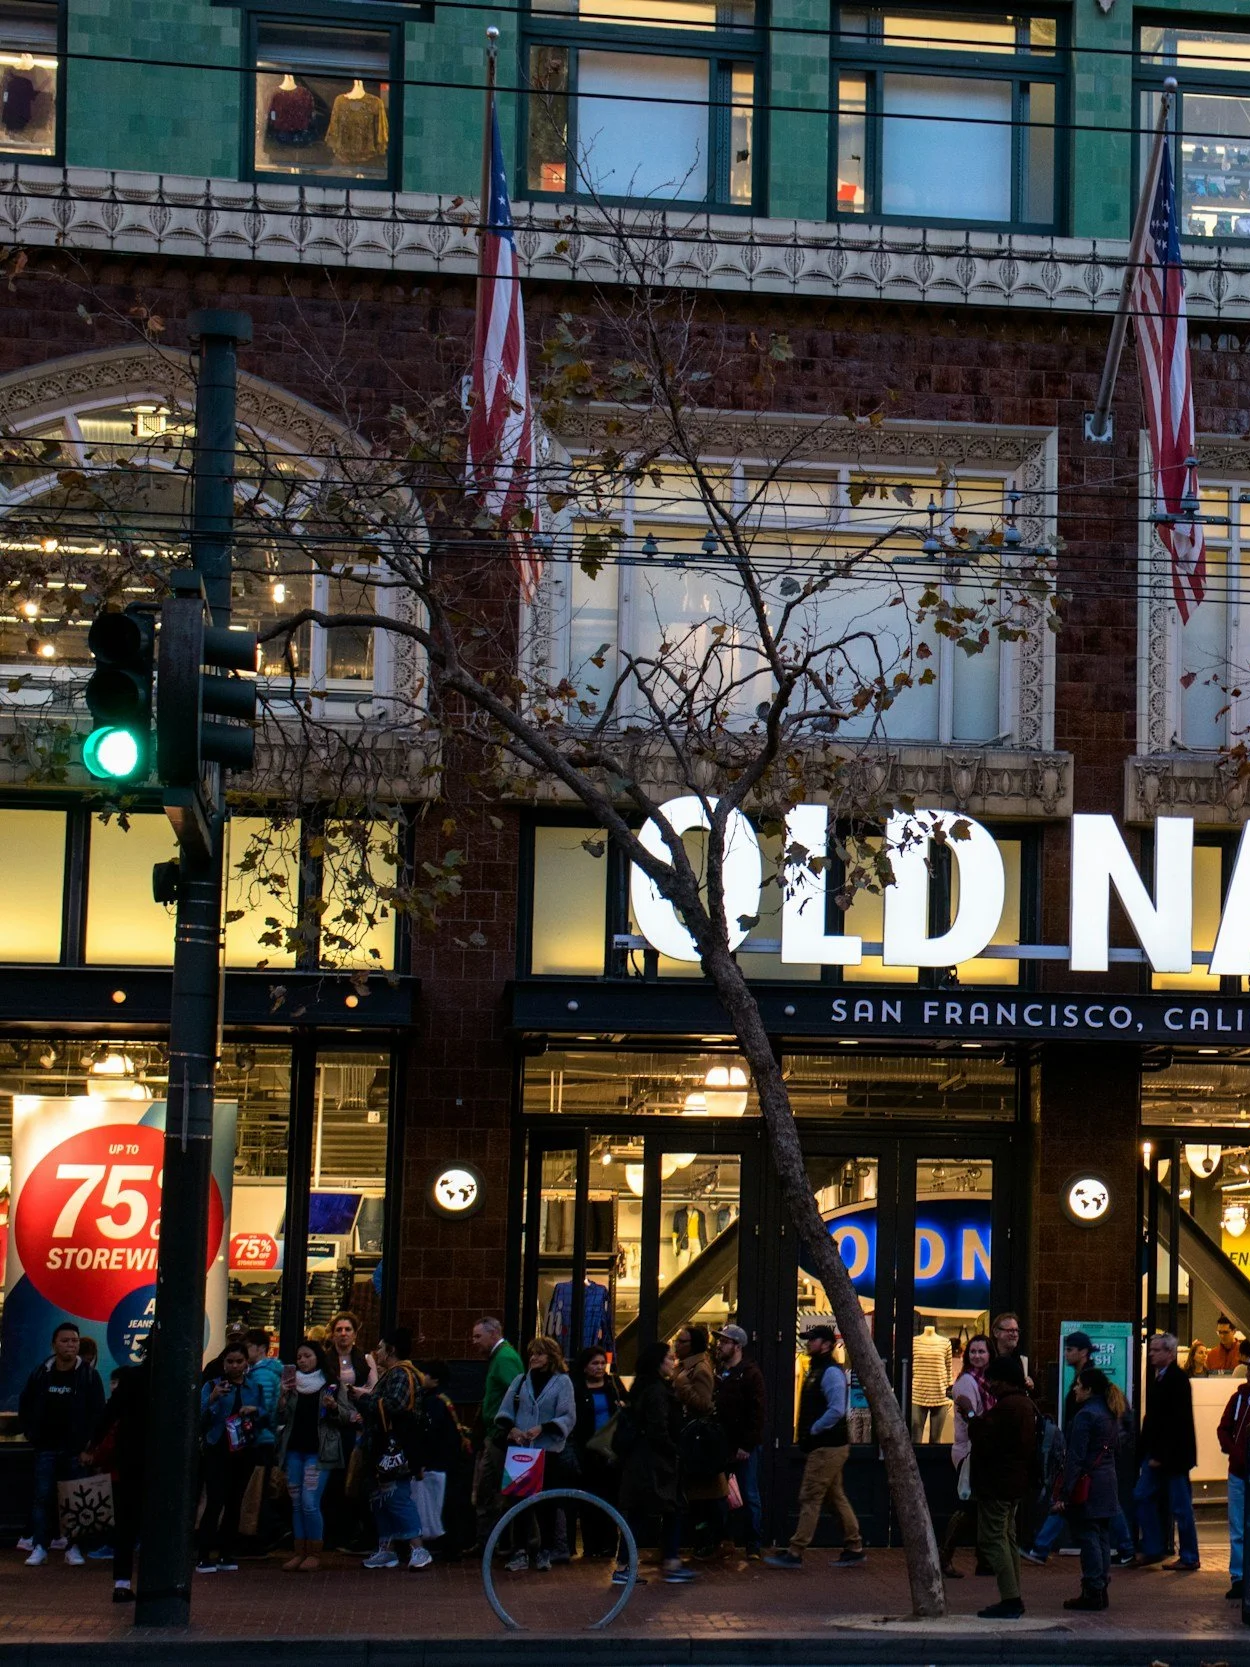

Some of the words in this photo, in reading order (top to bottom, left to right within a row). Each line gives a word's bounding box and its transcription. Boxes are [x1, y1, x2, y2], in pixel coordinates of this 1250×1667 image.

[629, 795, 1006, 968] OLD
[831, 999, 901, 1024] SAN
[923, 1001, 1143, 1033] FRANCISCO,
[109, 1144, 125, 1155] UP
[126, 1144, 140, 1155] TO
[51, 1164, 164, 1240] 75
[235, 1239, 271, 1259] 75%
